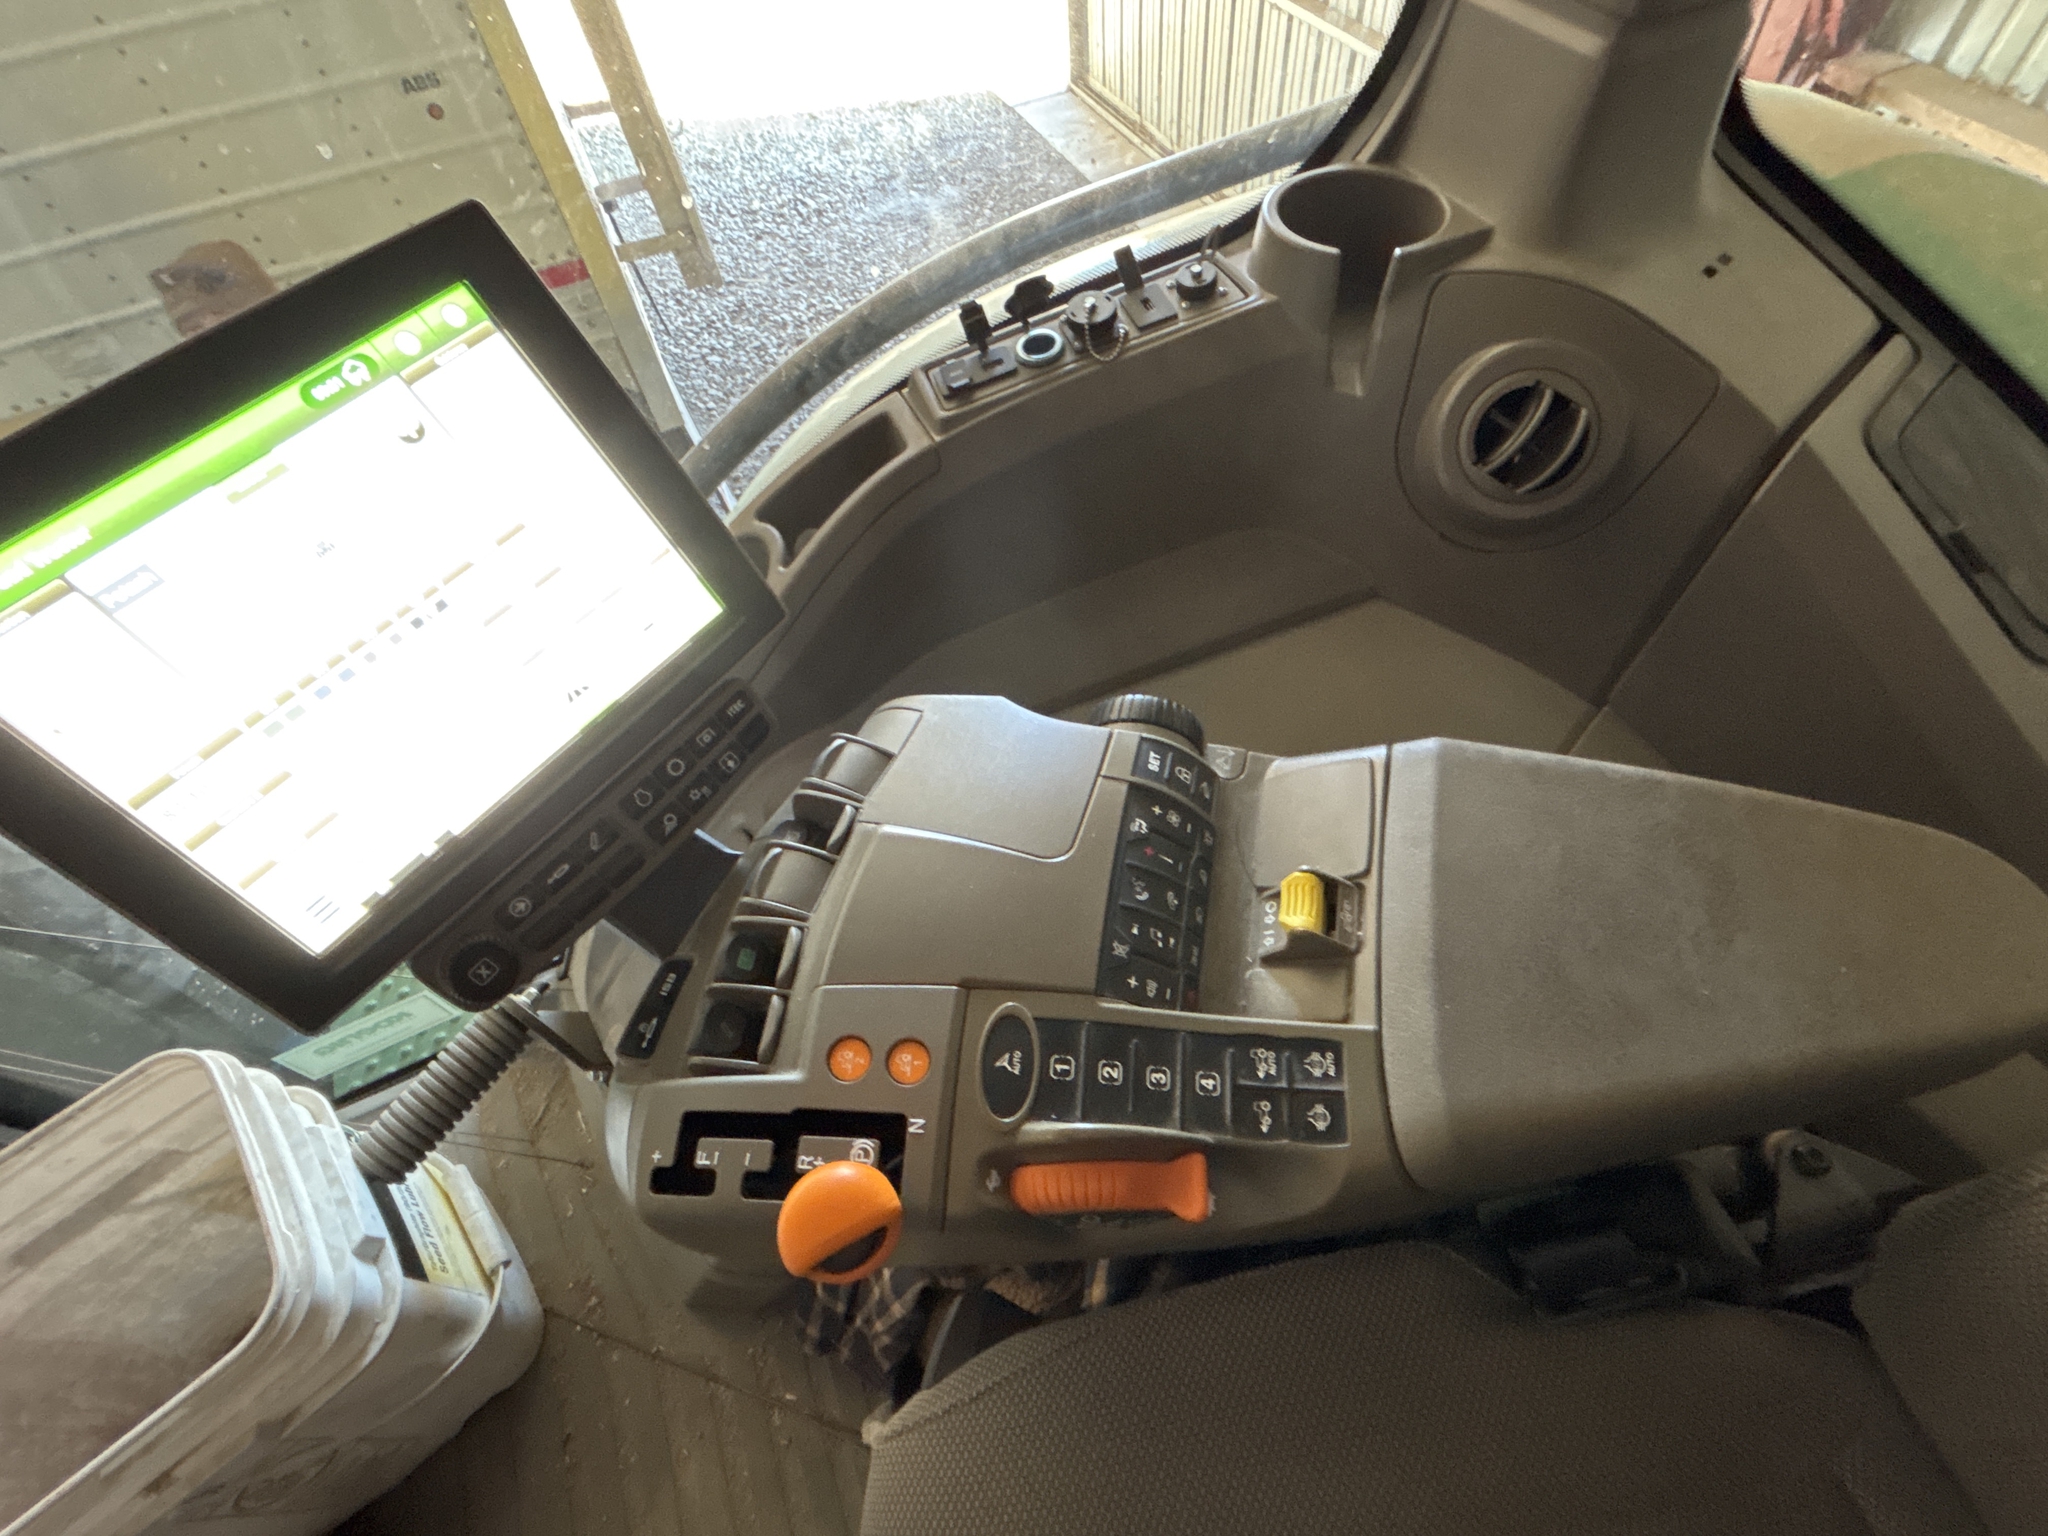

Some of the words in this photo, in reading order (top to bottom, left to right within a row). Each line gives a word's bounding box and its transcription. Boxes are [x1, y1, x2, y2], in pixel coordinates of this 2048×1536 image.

[401, 71, 441, 95] ABS
[1147, 750, 1161, 772] SET
[1012, 1050, 1022, 1075] AUTO
[1102, 1067, 1119, 1079] 2
[1267, 1051, 1277, 1076] AUTO
[1326, 1051, 1336, 1077] AUTO
[1150, 1073, 1166, 1085] 3
[1200, 1078, 1216, 1091] 4
[908, 1118, 926, 1134] N
[696, 1150, 712, 1166] F
[797, 1154, 815, 1170] R
[416, 1209, 434, 1239] Flow
[429, 1240, 449, 1274] Seed
